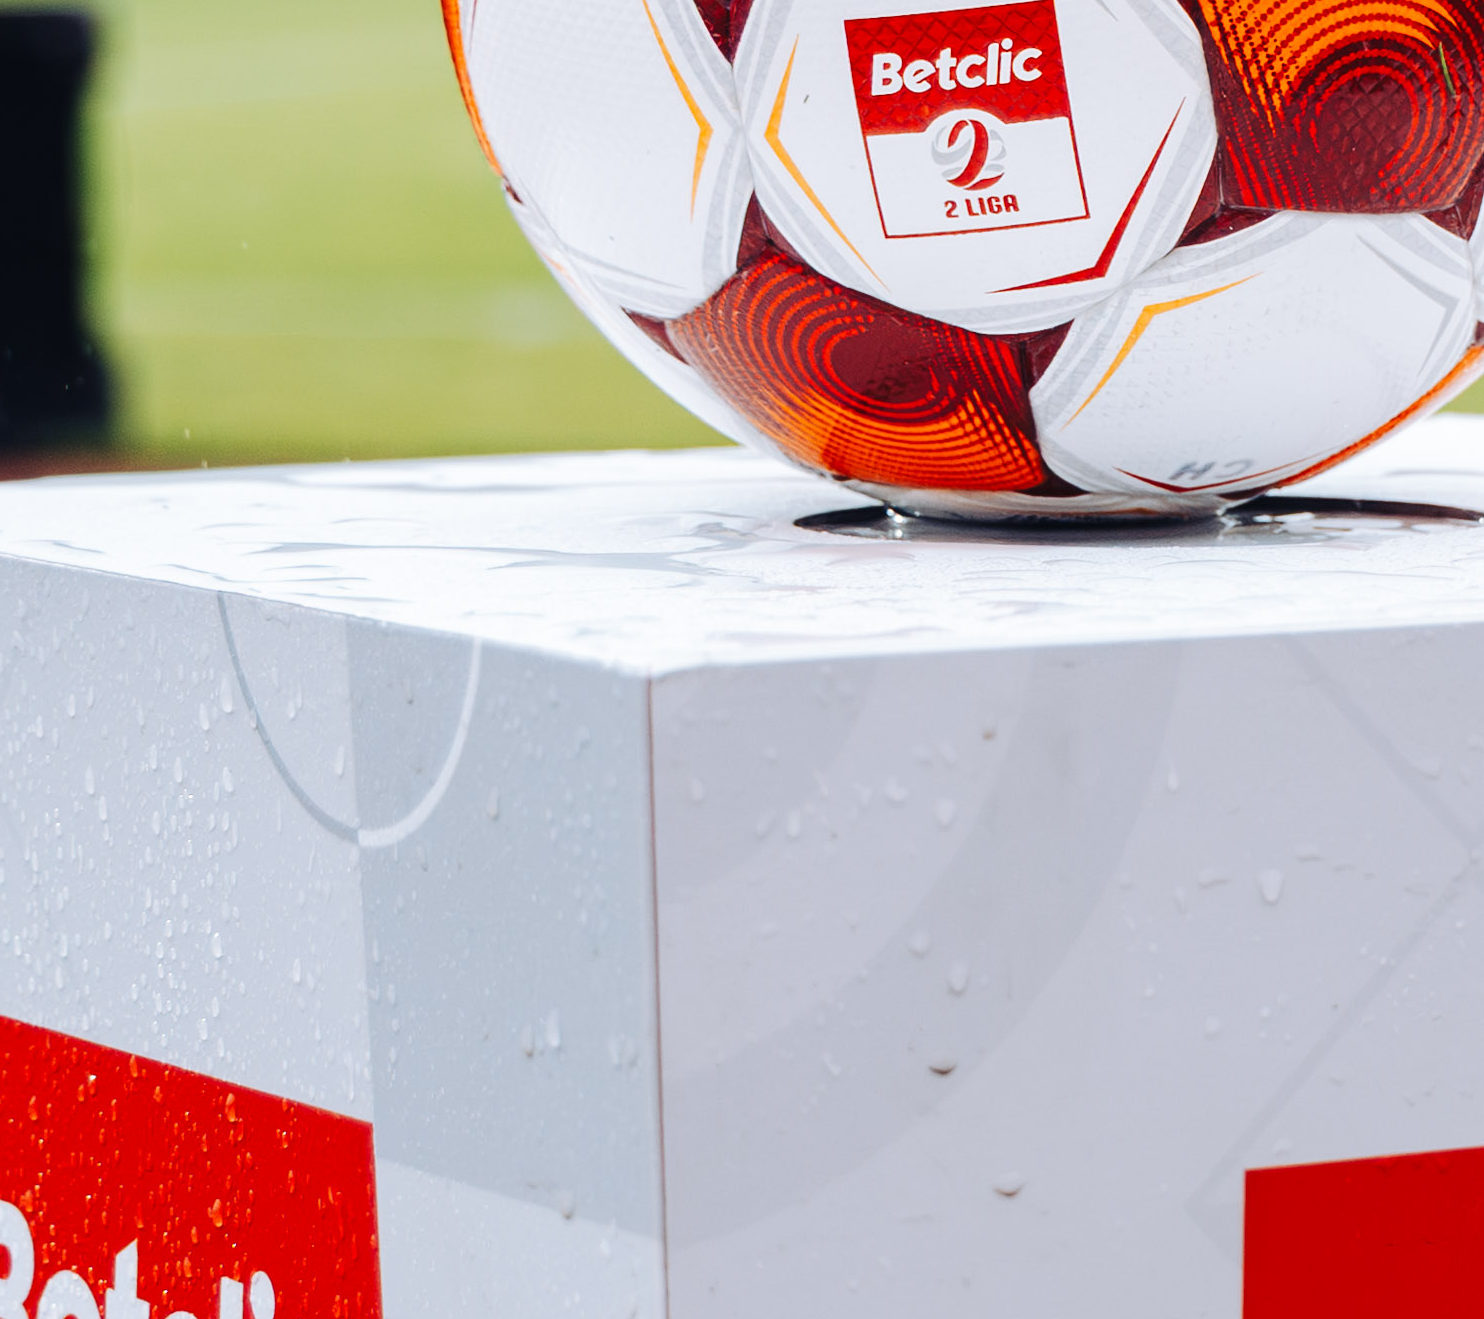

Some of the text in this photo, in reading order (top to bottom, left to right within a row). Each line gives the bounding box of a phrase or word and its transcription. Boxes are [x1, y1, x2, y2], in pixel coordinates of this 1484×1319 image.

[870, 37, 1043, 97] Betclic
[944, 194, 1020, 218] 2 LIGA
